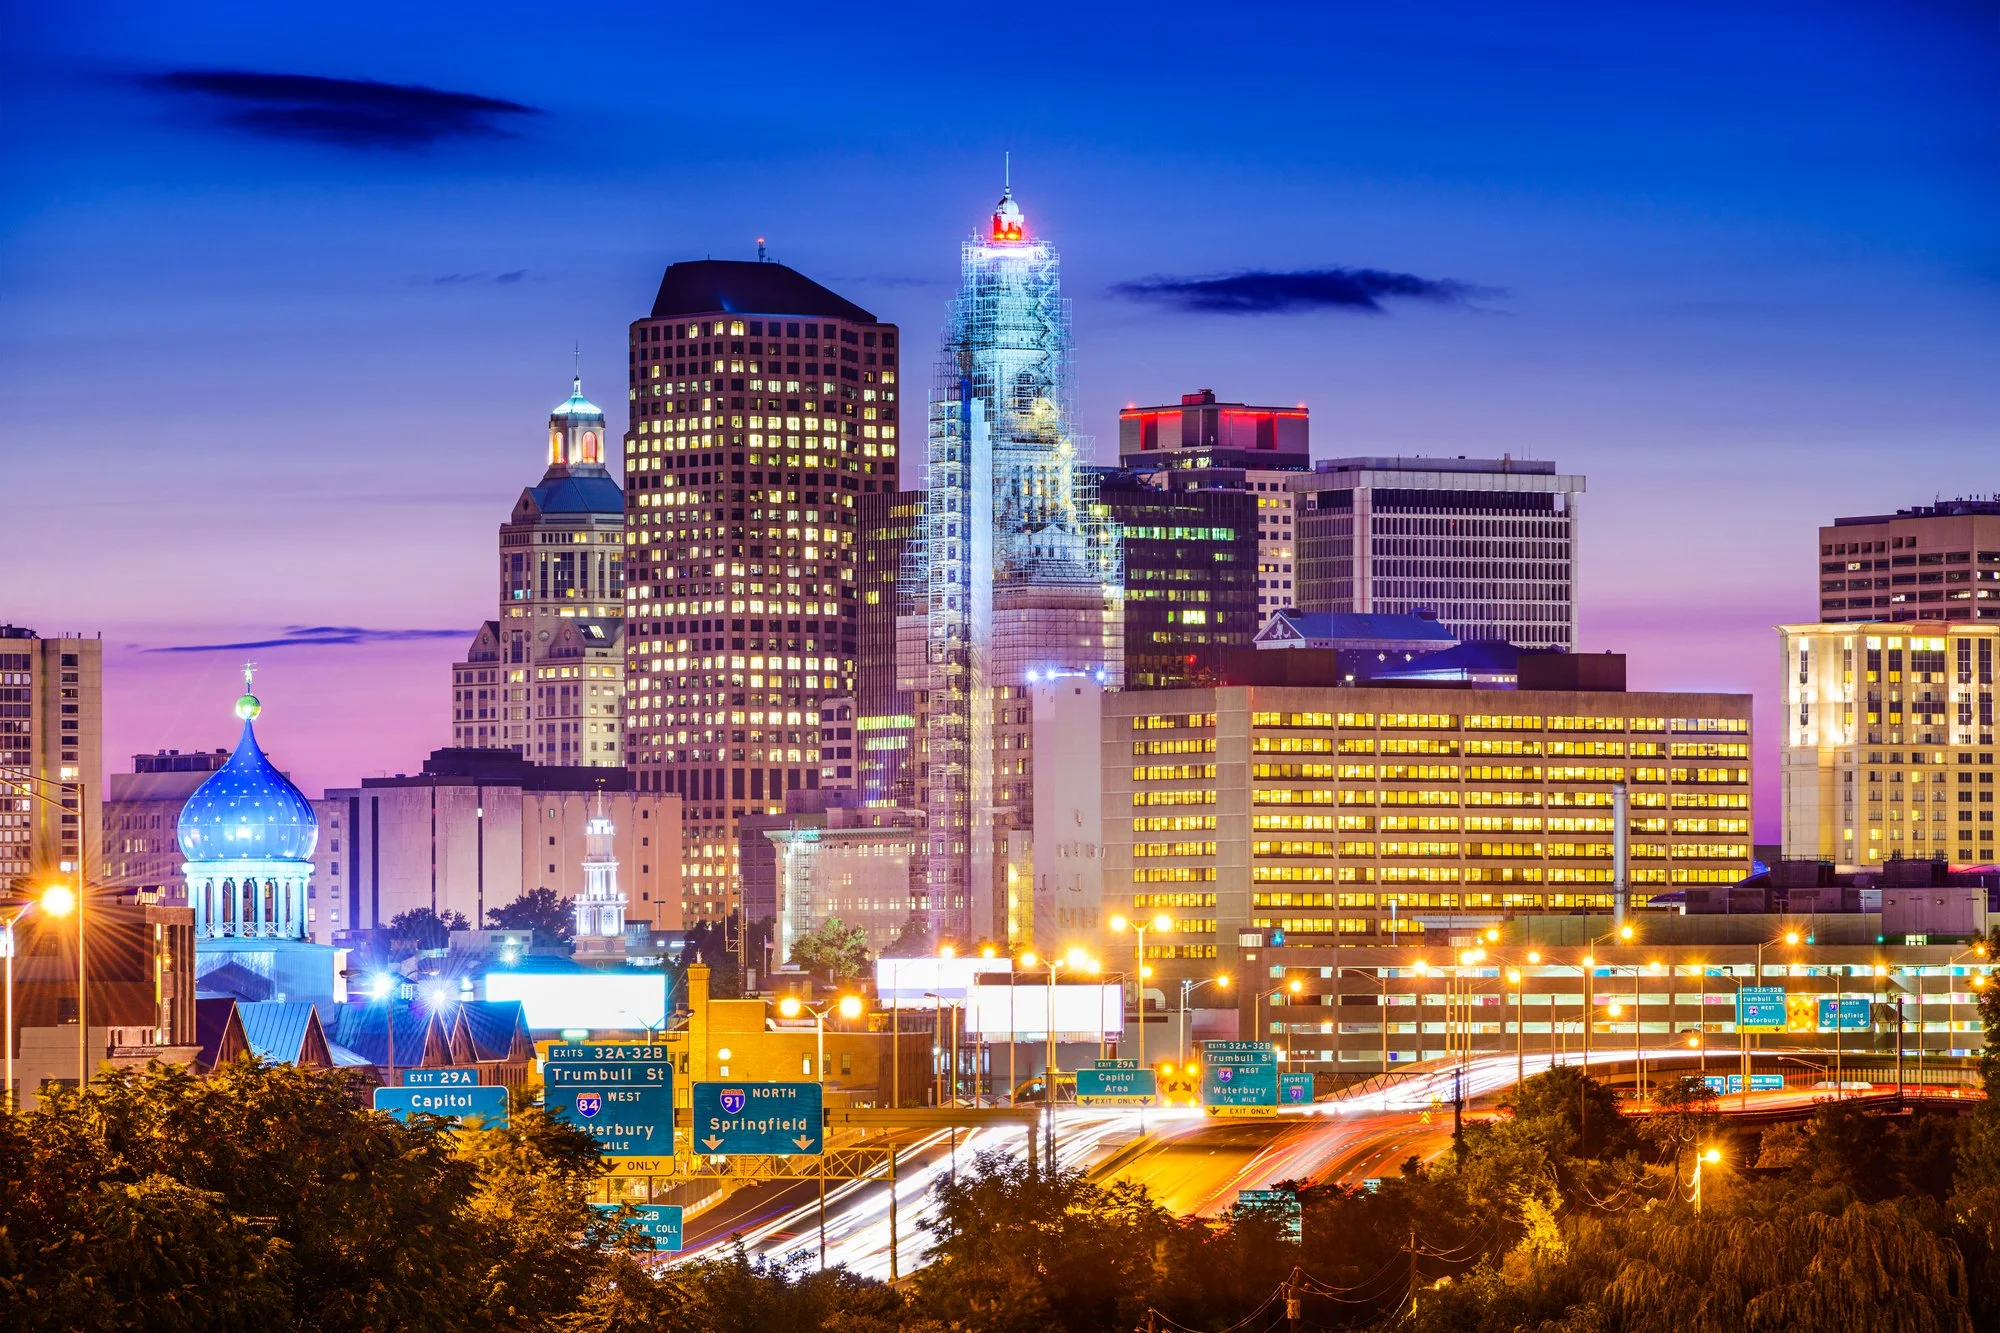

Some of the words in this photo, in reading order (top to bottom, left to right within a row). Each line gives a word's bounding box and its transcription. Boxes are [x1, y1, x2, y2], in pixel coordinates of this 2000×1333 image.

[1824, 1012, 1864, 1020] Sprngfield
[1229, 1042, 1271, 1050] 32A-32B
[553, 1049, 584, 1057] EXITS
[594, 1047, 663, 1059] 32A-32B
[1207, 1054, 1254, 1062] Trumbull
[1261, 1054, 1272, 1062] St
[410, 1074, 433, 1082] EXIT
[440, 1072, 471, 1084] 29A
[552, 1068, 632, 1080] Trumbull
[646, 1068, 664, 1080] St
[1098, 1073, 1134, 1082] Capitol
[1219, 1071, 1231, 1079] 84
[752, 1088, 796, 1098] NORTH
[1104, 1084, 1129, 1092] Area
[1213, 1086, 1267, 1096] Waterbury
[411, 1094, 472, 1109] Capitol
[579, 1100, 598, 1111] 84
[607, 1092, 641, 1102] WEST
[724, 1097, 739, 1107] 91
[710, 1118, 806, 1134] Springfield
[603, 1142, 629, 1150] MILE
[627, 1161, 660, 1171] ONLY
[656, 1224, 678, 1233] COLL
